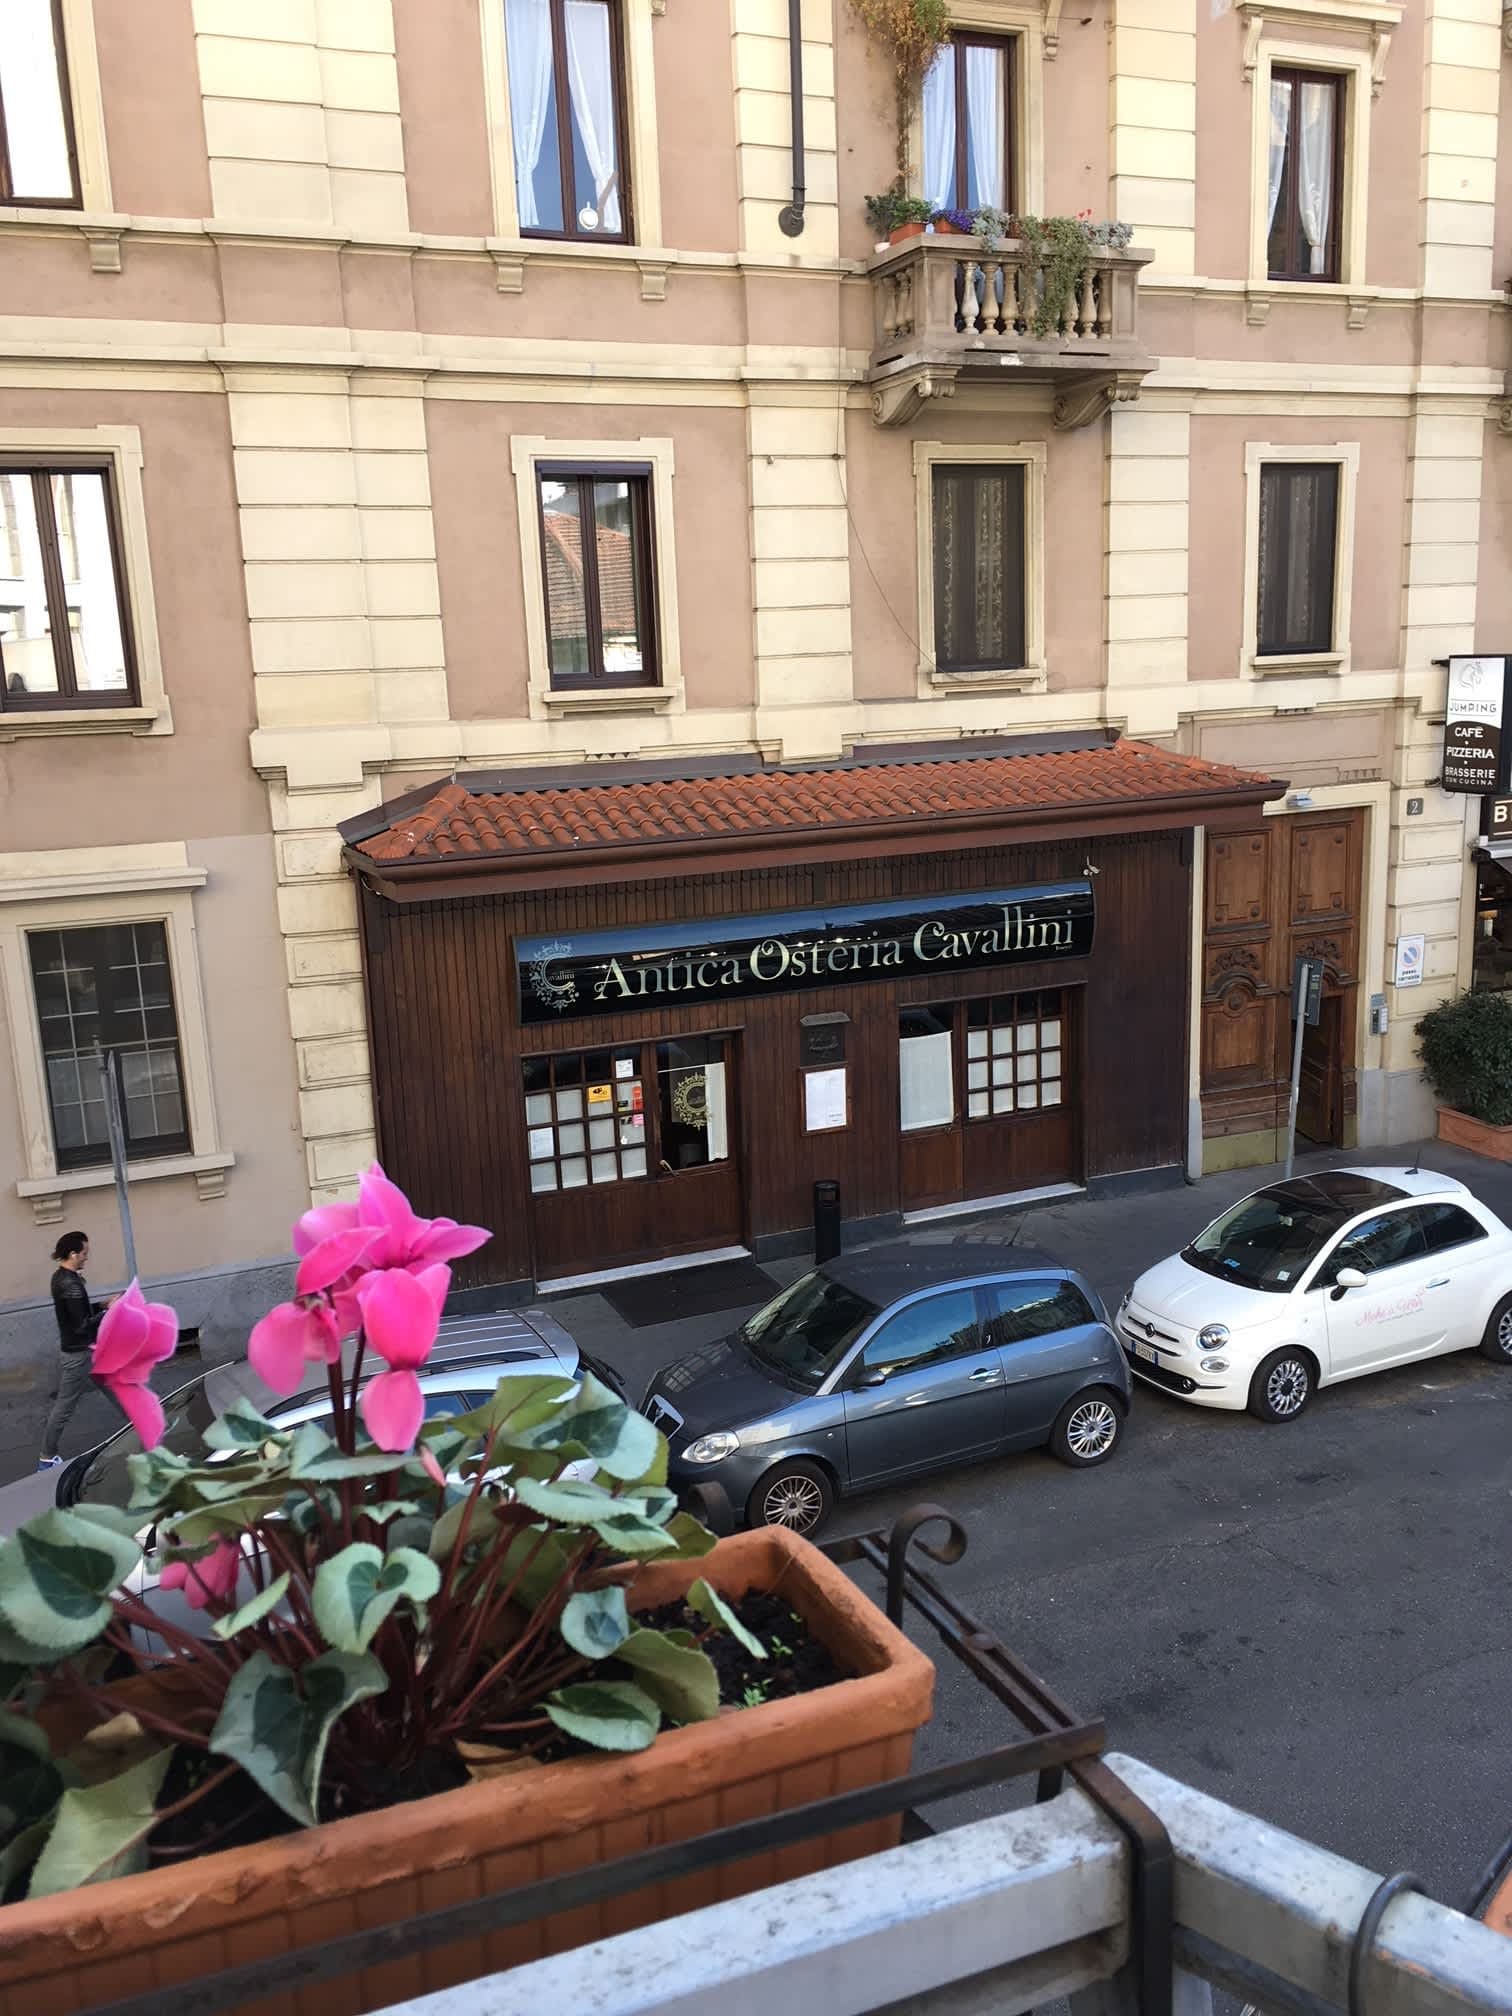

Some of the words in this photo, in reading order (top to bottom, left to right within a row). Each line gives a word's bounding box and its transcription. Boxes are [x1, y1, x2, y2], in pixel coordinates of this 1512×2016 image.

[1449, 703, 1496, 713] JUMPING
[1446, 746, 1495, 759] PIZZERIA
[1445, 766, 1496, 779] BRASSERIE
[1459, 778, 1493, 786] CUCINA
[1411, 800, 1419, 814] 2
[593, 951, 744, 1001] Antica
[750, 930, 904, 981] Osteria
[914, 905, 1074, 961] Cavallini
